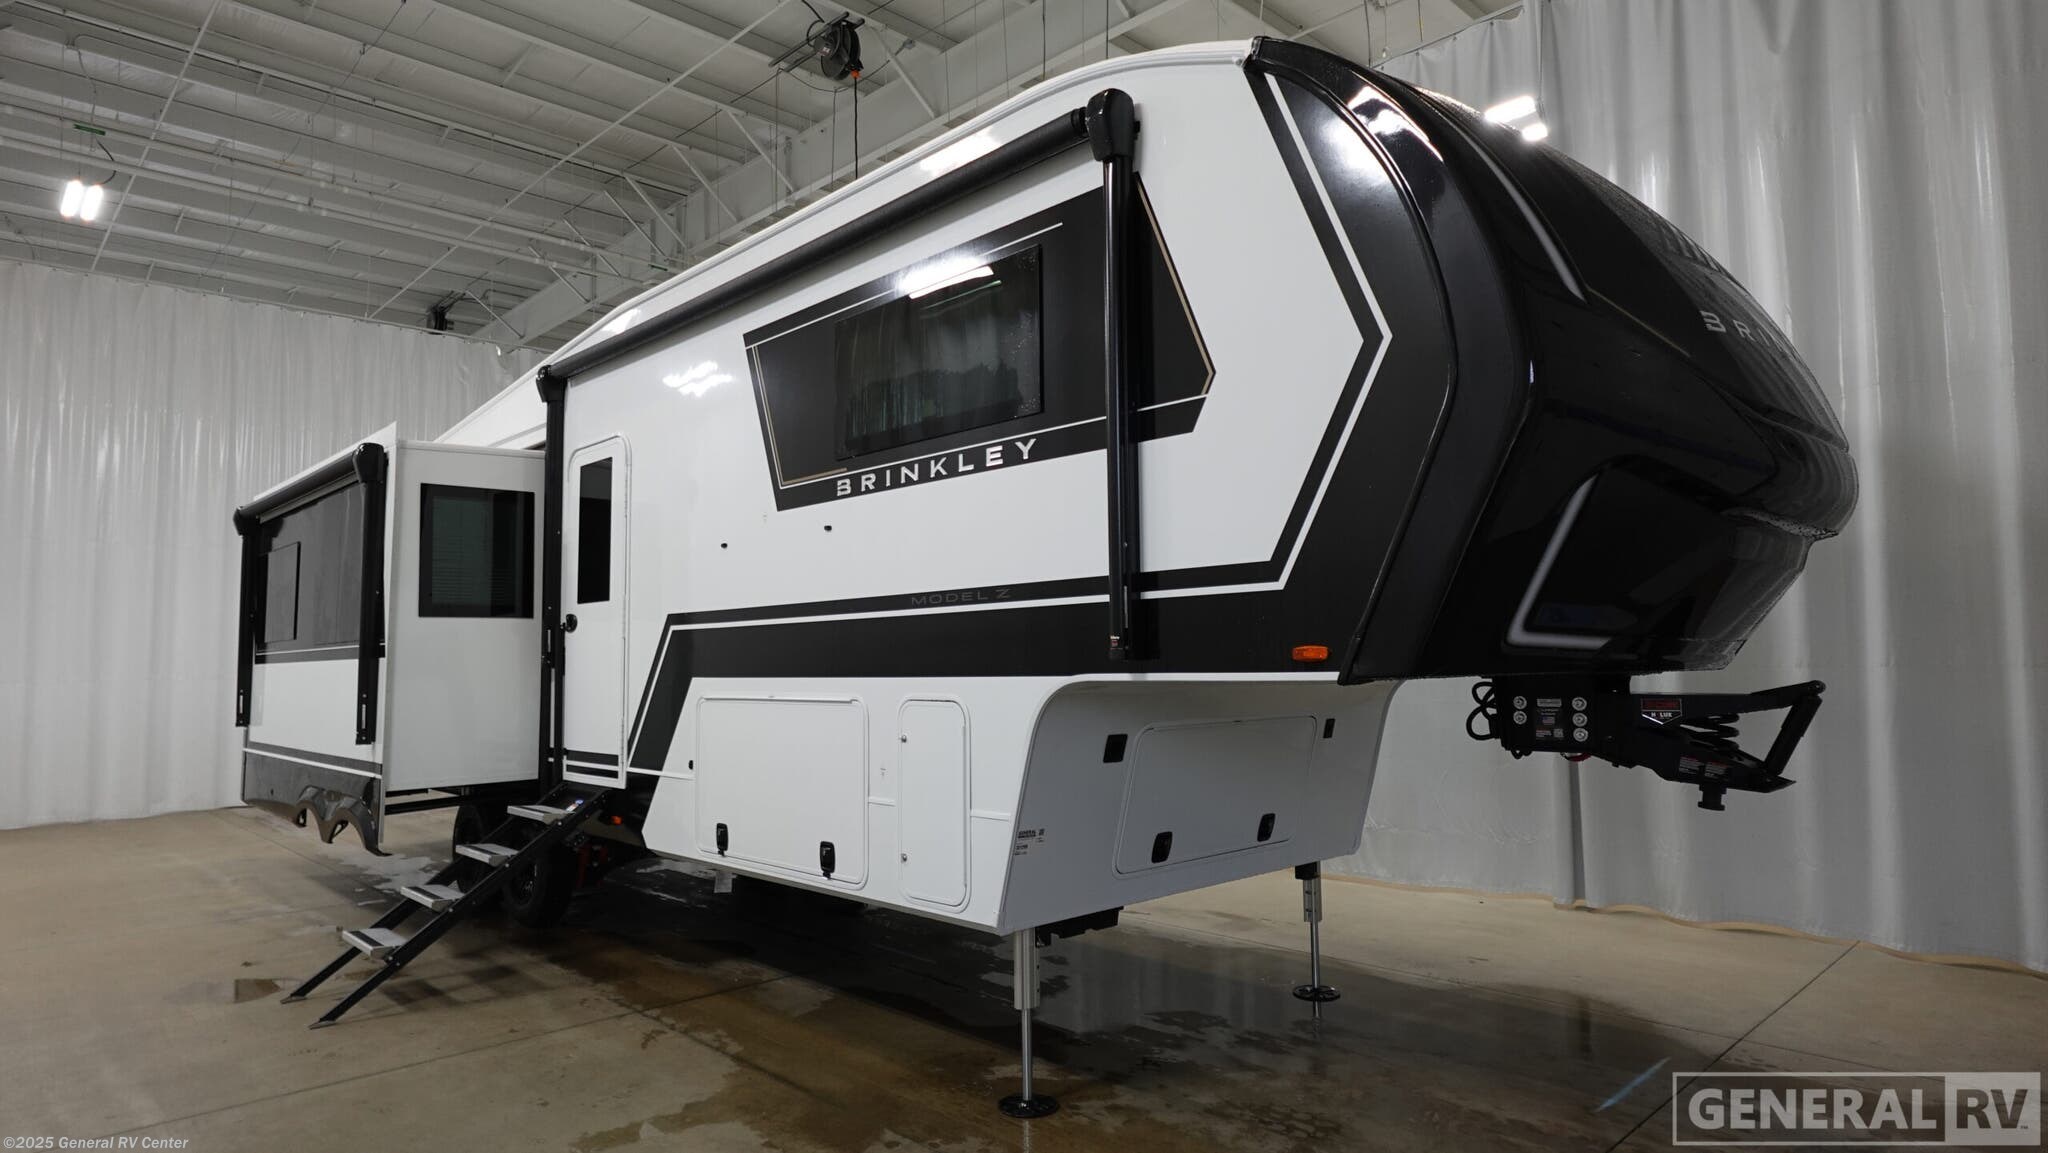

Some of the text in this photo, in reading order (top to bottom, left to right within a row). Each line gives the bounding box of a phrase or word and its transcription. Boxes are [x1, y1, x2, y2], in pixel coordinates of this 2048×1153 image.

[837, 438, 1037, 497] BRINKLEY
[911, 588, 1011, 606] MODEL Z
